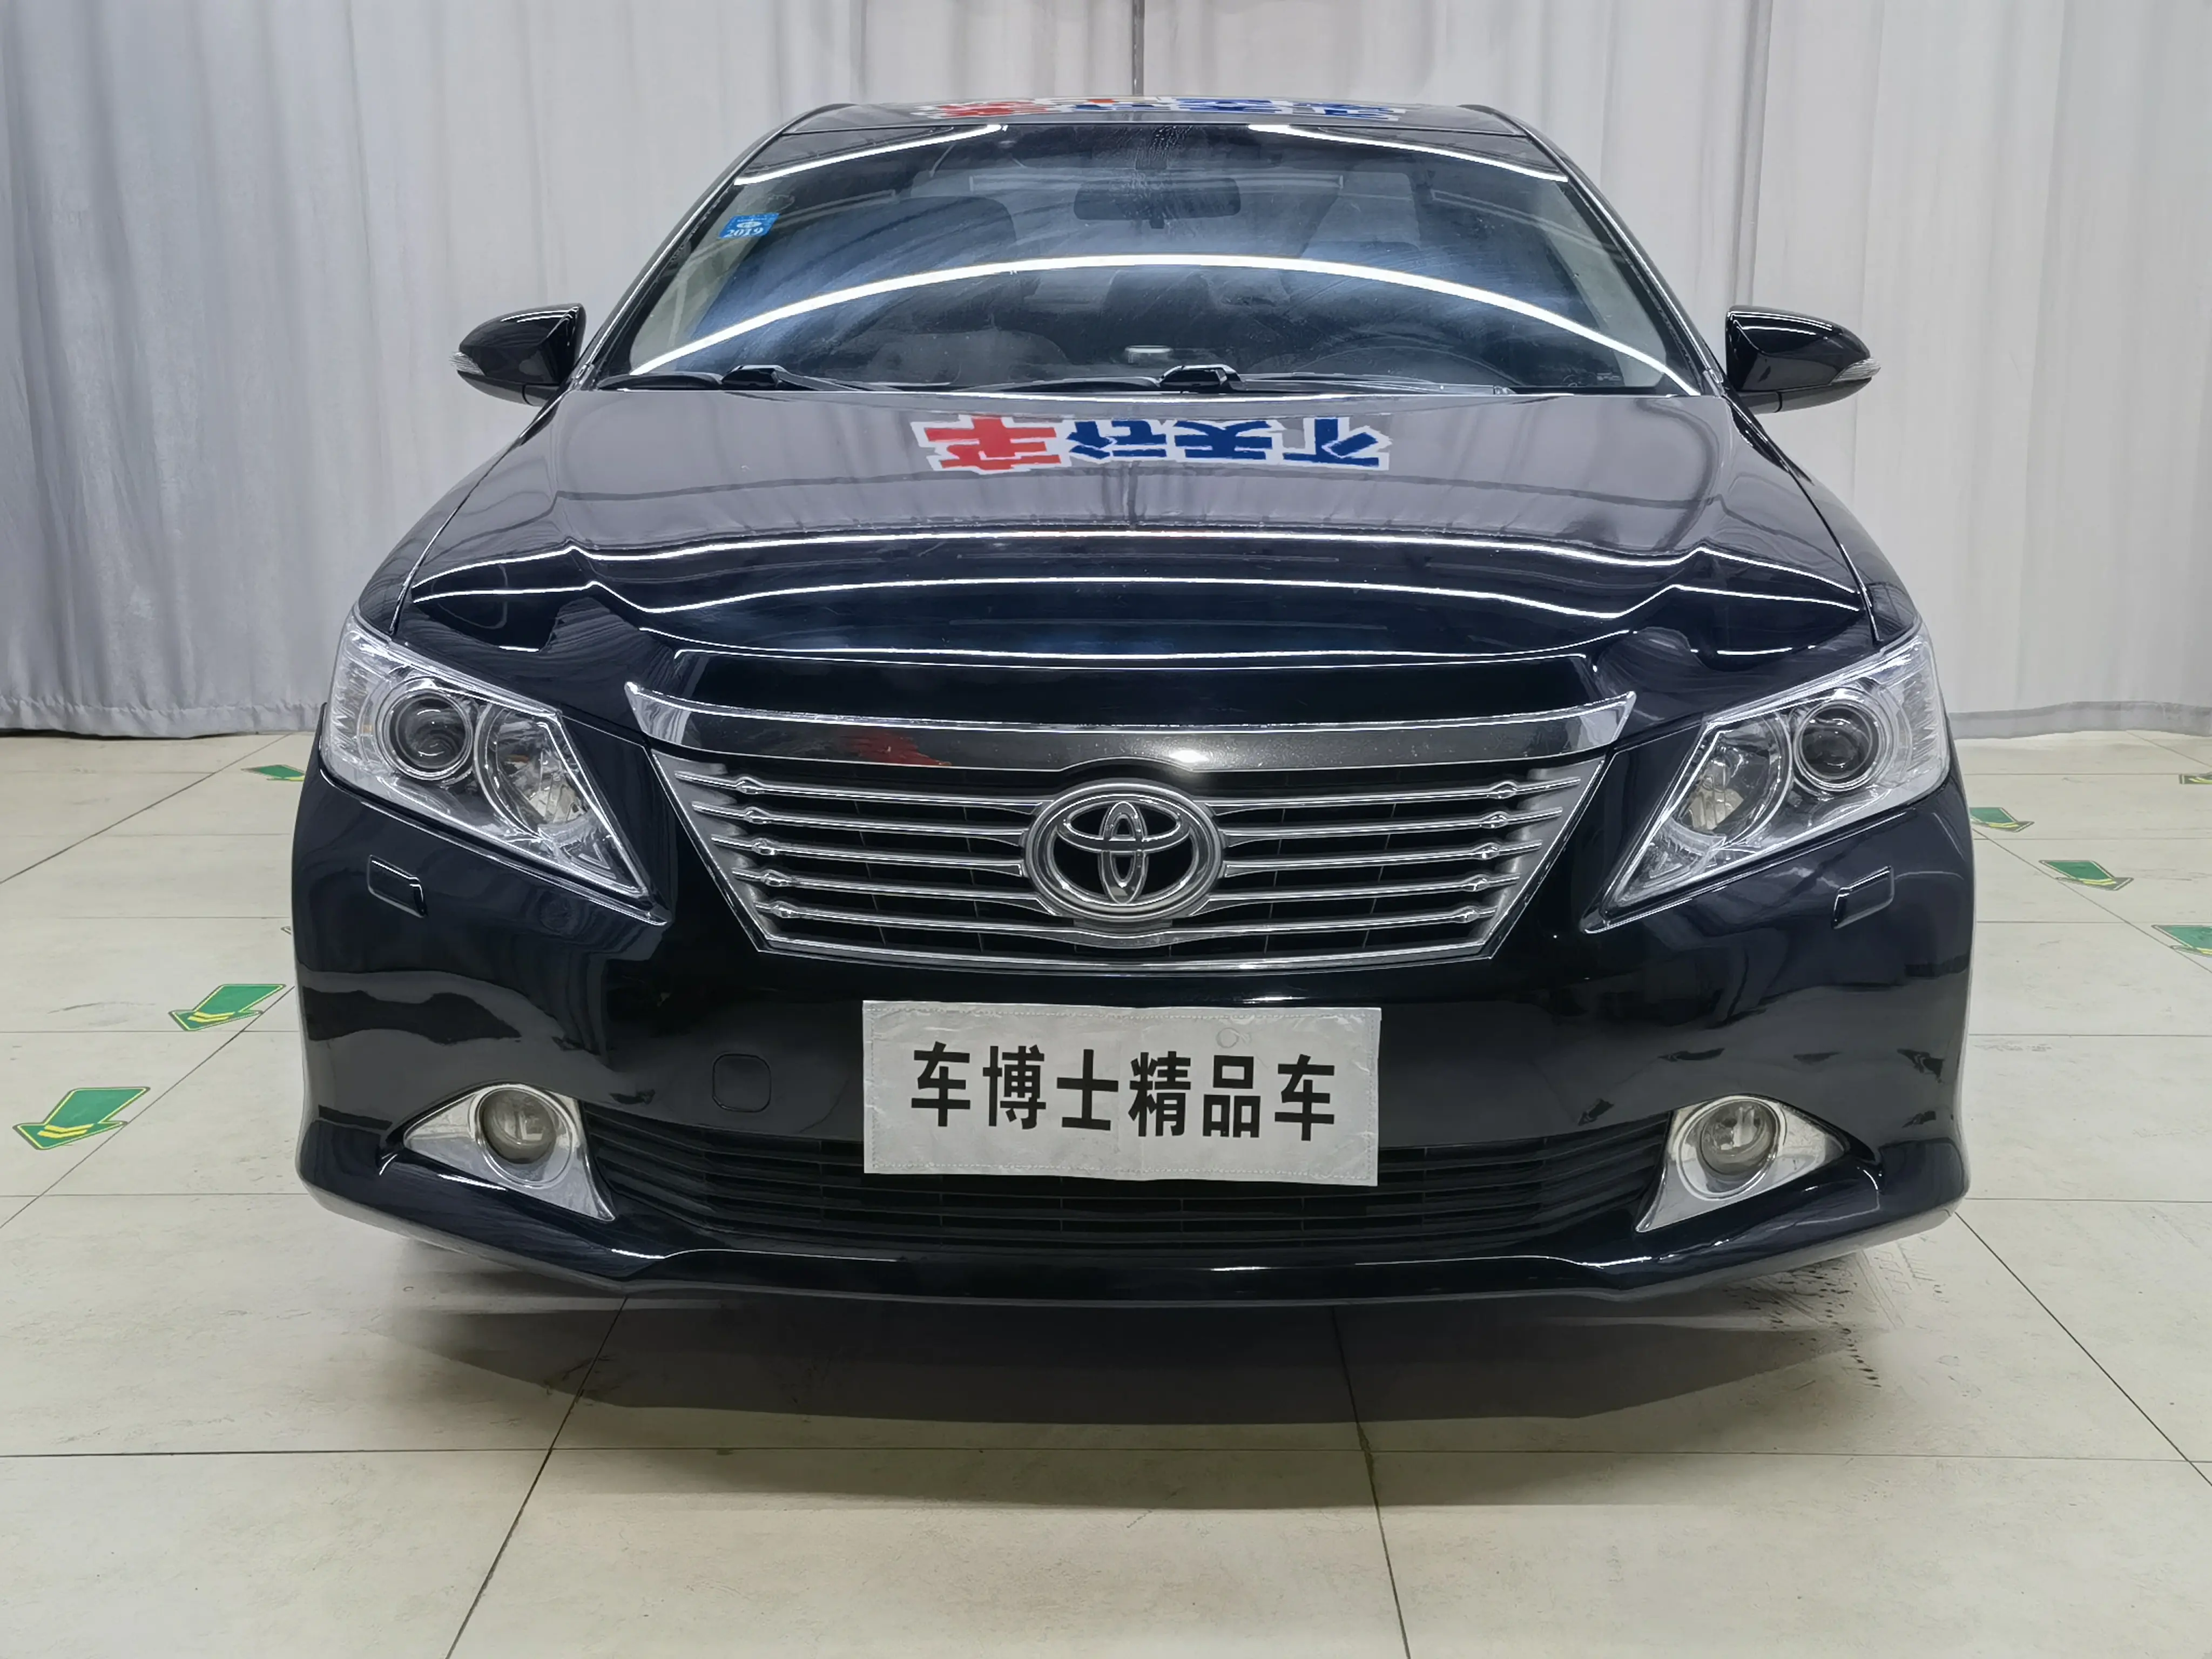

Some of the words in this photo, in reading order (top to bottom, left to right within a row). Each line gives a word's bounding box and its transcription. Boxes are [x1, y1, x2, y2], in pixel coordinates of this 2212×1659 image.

[727, 227, 764, 237] 2019
[911, 1042, 1336, 1141] 车博士精品车
